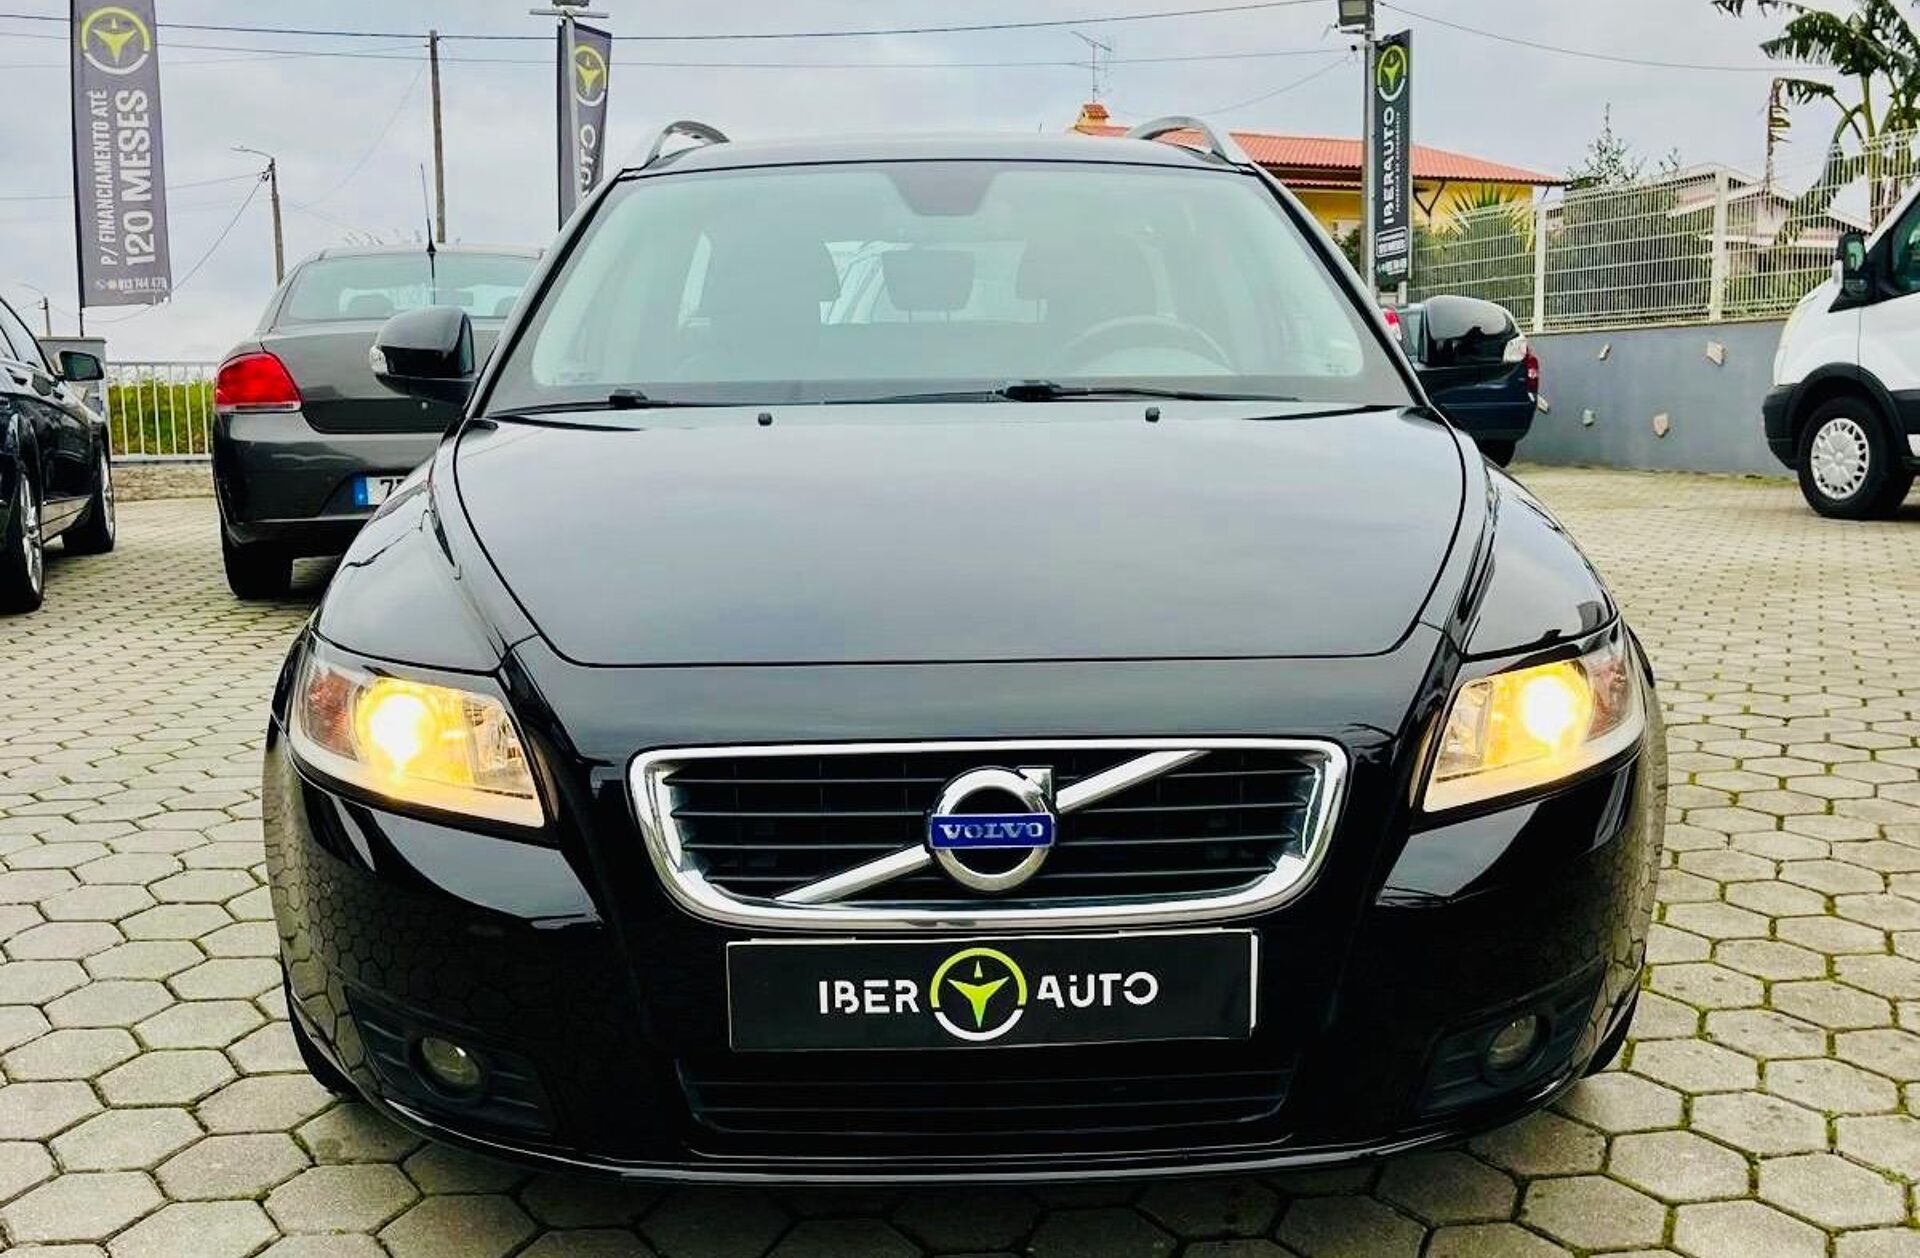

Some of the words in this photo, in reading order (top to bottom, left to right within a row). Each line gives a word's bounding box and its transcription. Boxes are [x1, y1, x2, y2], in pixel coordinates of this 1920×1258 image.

[86, 89, 109, 117] ATÉ
[115, 89, 153, 201] MESES
[1383, 106, 1395, 225] IBERAUTO
[92, 121, 116, 243] FINANCIAMENTO
[123, 211, 156, 266] 120
[938, 822, 1044, 840] VOLVO
[818, 979, 920, 1014] IBER
[1036, 971, 1159, 1009] AUTO
